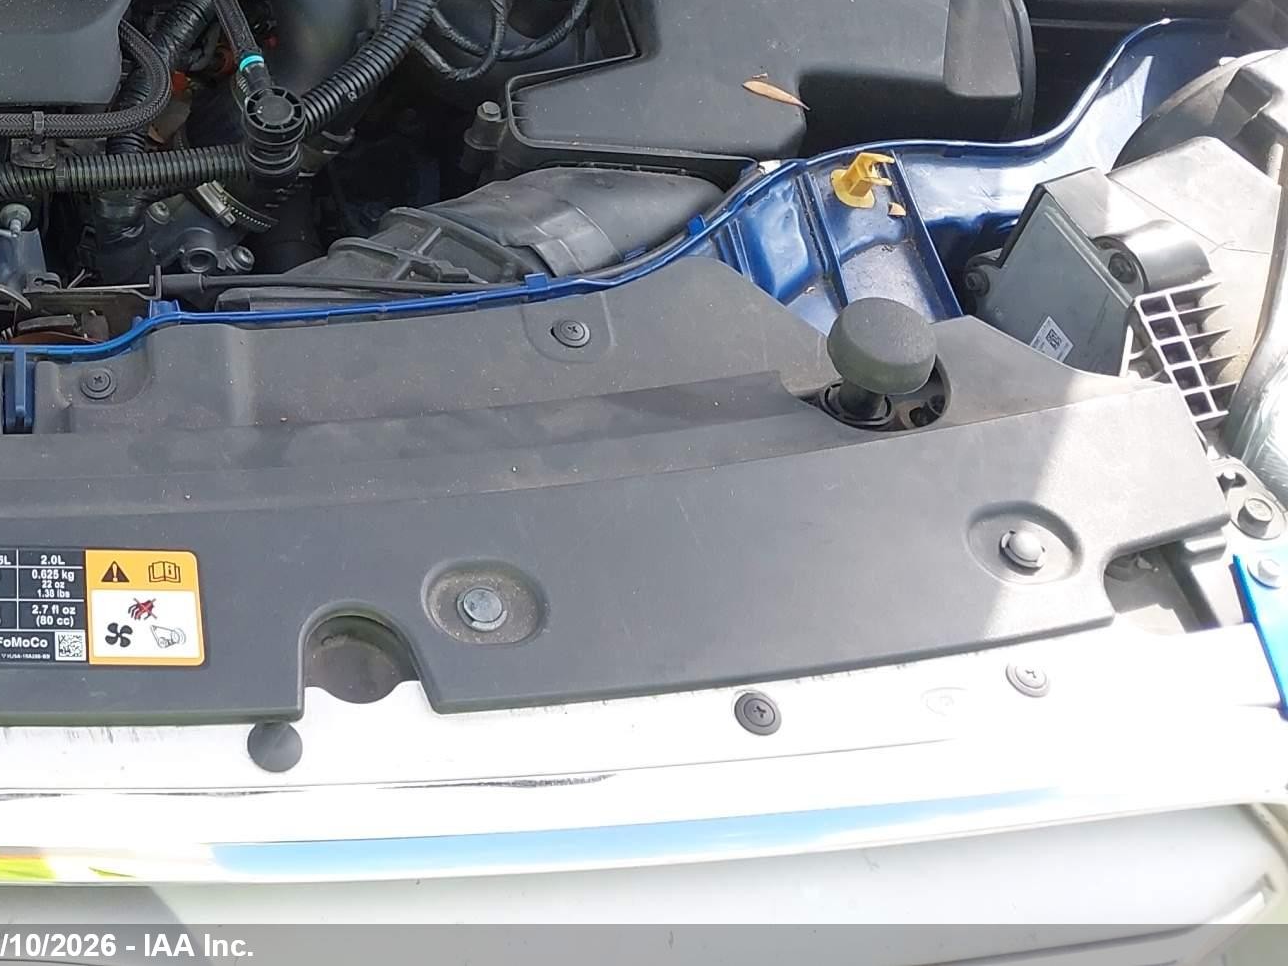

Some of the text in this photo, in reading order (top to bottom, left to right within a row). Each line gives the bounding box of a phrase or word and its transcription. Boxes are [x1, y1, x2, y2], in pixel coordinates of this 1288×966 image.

[40, 555, 65, 565] 2.0L
[31, 569, 75, 582] 0.625 kg
[41, 580, 65, 589] 22 oz
[56, 589, 70, 598] lbs
[31, 605, 76, 615] 2.7 fl oz
[36, 615, 74, 627] (80 cc)
